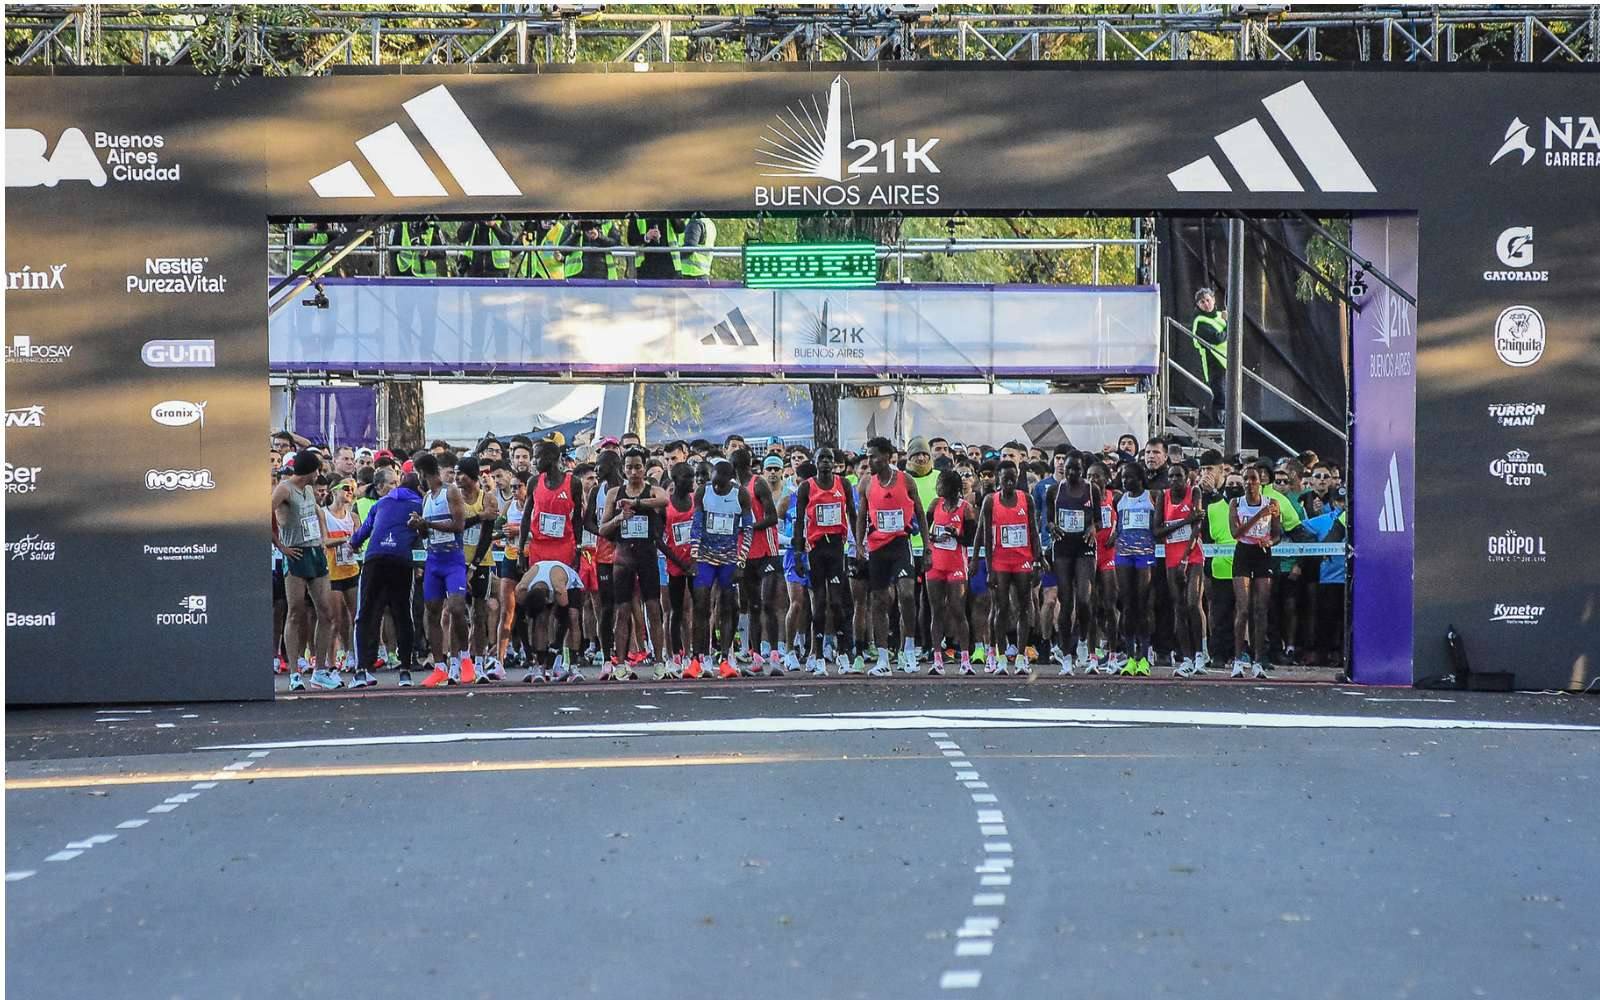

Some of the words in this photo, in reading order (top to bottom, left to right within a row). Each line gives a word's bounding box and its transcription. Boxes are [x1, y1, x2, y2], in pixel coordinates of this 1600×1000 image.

[95, 132, 164, 148] Buenos
[107, 149, 158, 164] Aires
[848, 138, 941, 173] 21K
[113, 164, 180, 181] Ciudad
[755, 186, 860, 205] BUENOS
[868, 185, 939, 204] AIRES
[146, 257, 203, 274] Nestlé
[1484, 271, 1548, 280] GATORADE
[127, 275, 223, 293] PurezaVital
[829, 327, 864, 344] 21K
[30, 345, 73, 358] POSAY
[794, 347, 834, 358] BUENOS
[837, 348, 865, 358] AIRES
[1498, 338, 1542, 355] Chiquita
[1370, 352, 1394, 377] BUENOS
[1394, 351, 1411, 376] AIRES
[155, 408, 193, 418] Granix
[1488, 403, 1546, 417] TURRÓN
[1489, 459, 1547, 479] Corona
[146, 470, 214, 489] MOGUL
[1505, 474, 1531, 486] Cero
[144, 545, 191, 554] Prevención
[192, 544, 217, 554] Salud
[1489, 537, 1533, 554] GRUPO
[1539, 537, 1546, 554] L
[30, 551, 55, 560] Salud
[1494, 603, 1545, 616] Kynetar
[6, 612, 55, 626] Basani
[157, 613, 207, 624] FOTORUN
